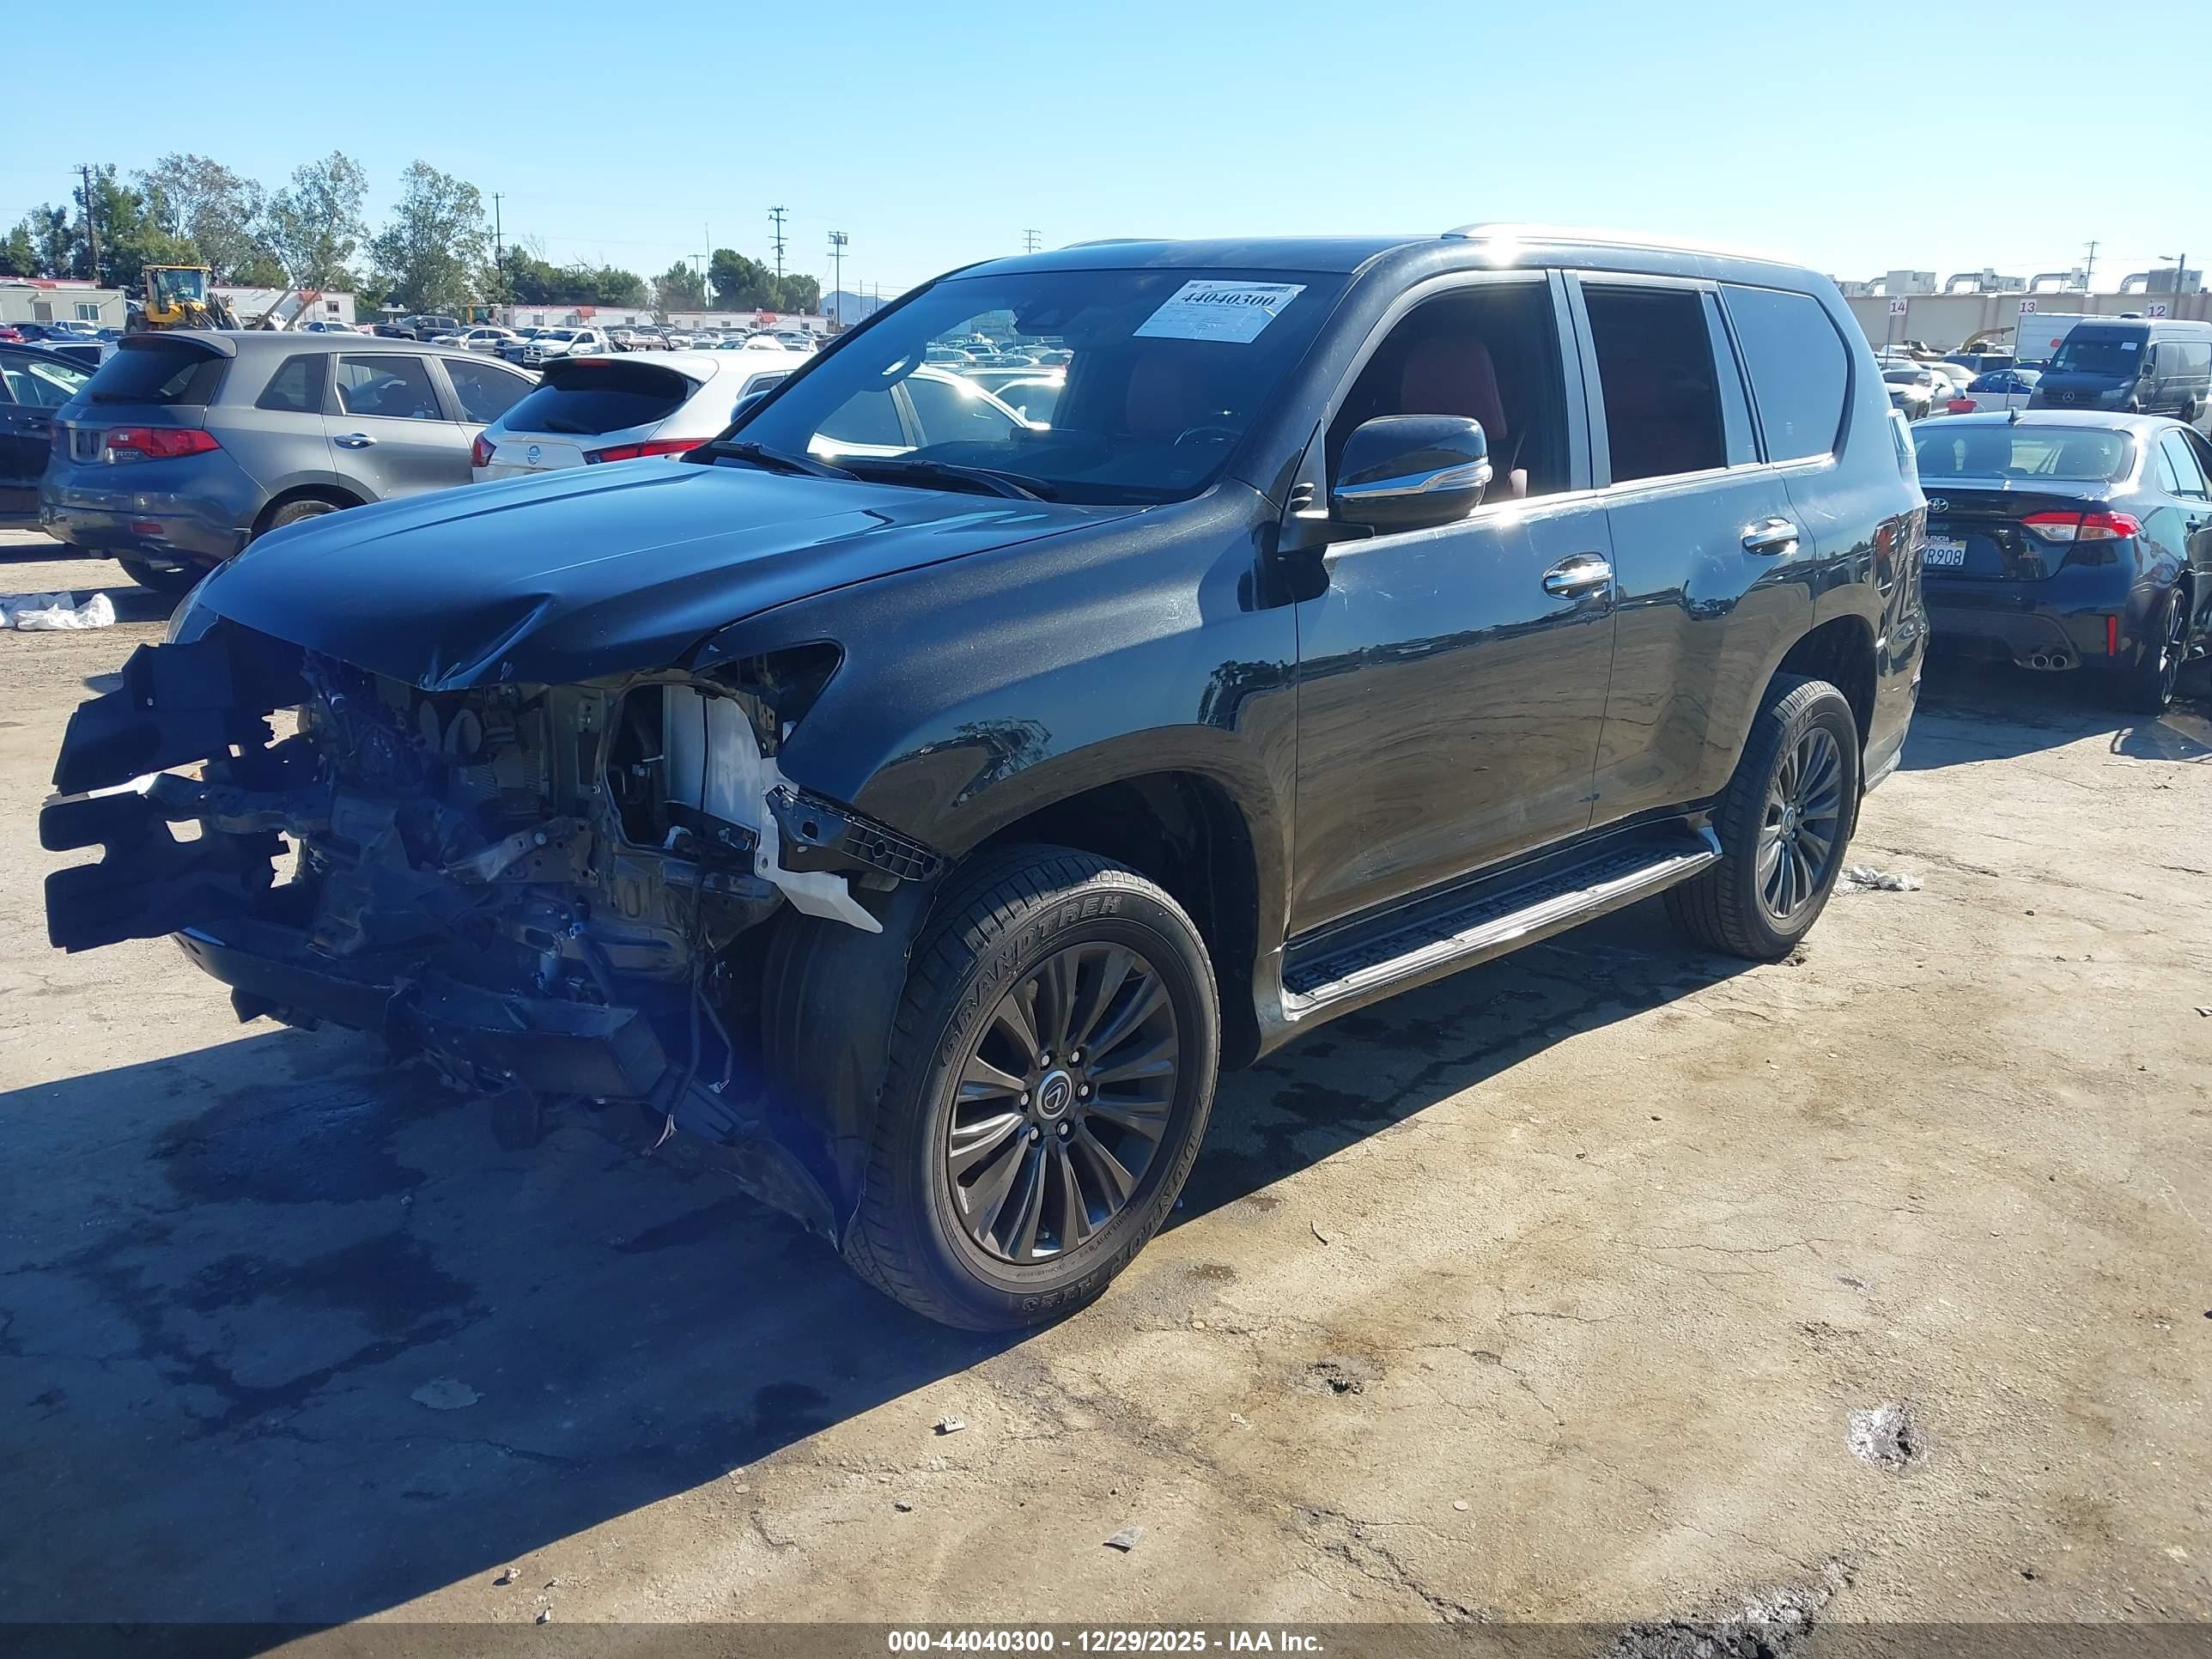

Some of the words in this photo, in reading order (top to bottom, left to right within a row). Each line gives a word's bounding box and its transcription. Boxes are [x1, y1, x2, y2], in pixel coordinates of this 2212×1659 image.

[1181, 292, 1277, 307] 44040300
[1890, 301, 1905, 313] 14
[2019, 301, 2035, 313] 13
[2148, 306, 2166, 317] 12
[1923, 549, 1961, 564] R908
[941, 896, 1122, 1066] GRANDTREK
